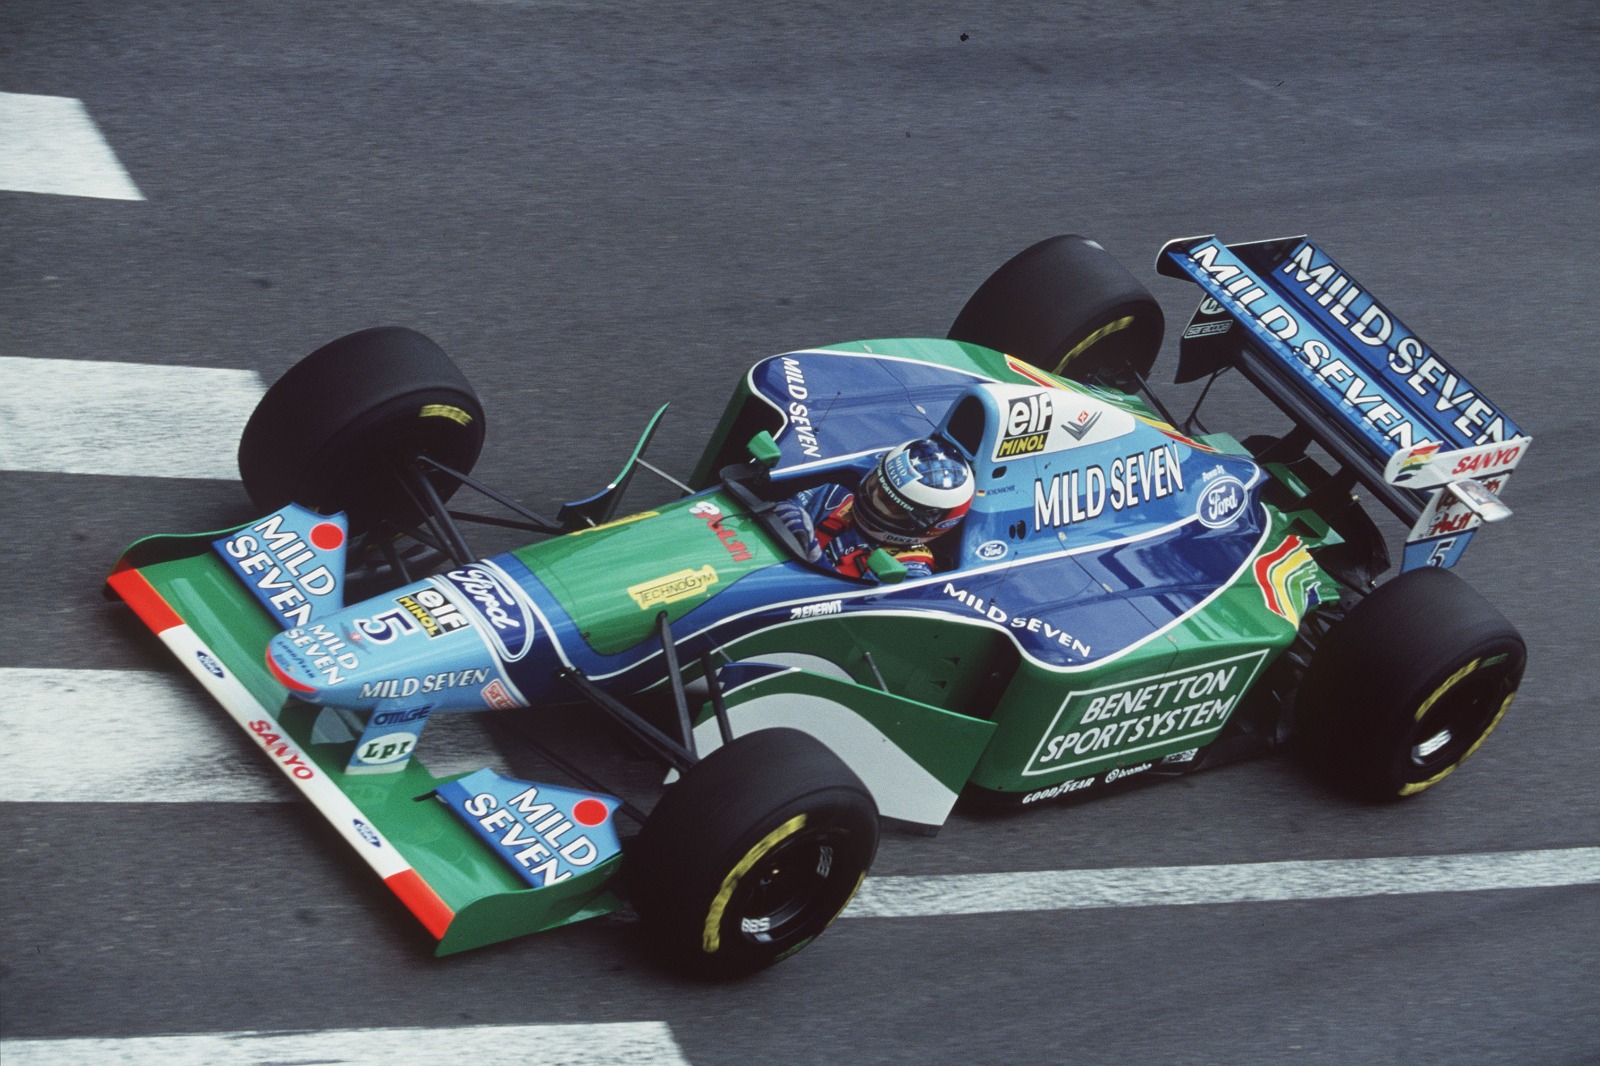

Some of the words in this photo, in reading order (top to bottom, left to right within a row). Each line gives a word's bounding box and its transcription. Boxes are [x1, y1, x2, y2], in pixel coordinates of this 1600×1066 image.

[1191, 245, 1299, 341] MILD
[1294, 339, 1437, 452] SEVEN
[1284, 245, 1394, 347] MILD
[1388, 336, 1522, 446] SEVEN
[782, 356, 808, 401] MILD
[789, 402, 821, 458] SEVEN
[1008, 393, 1053, 436] elf
[894, 456, 909, 477] MILD
[999, 434, 1044, 457] MINOL
[1451, 446, 1521, 475] SANYO
[1033, 463, 1107, 532] MILD
[1110, 440, 1184, 512] SEVEN
[1208, 484, 1239, 520] Ford
[225, 534, 313, 628] SEVEN
[252, 513, 337, 598] MILD
[1426, 538, 1457, 568] 5
[353, 606, 420, 645] 5
[399, 596, 441, 637] MINOL
[416, 590, 469, 629] elf
[448, 568, 521, 630] Ford
[943, 583, 1008, 624] MILD
[1010, 617, 1092, 658] SEVEN
[284, 628, 345, 686] SEVEN
[306, 624, 359, 670] MILD
[358, 677, 420, 699] MILD
[421, 667, 491, 693] SEVEN
[1079, 666, 1238, 726] BENETTON
[248, 719, 314, 781] SANYO
[1039, 694, 1237, 763] SPORTSYSTEM
[1022, 777, 1096, 804] GOODYEAR
[464, 792, 573, 887] SEVEN
[507, 786, 598, 867] MILD
